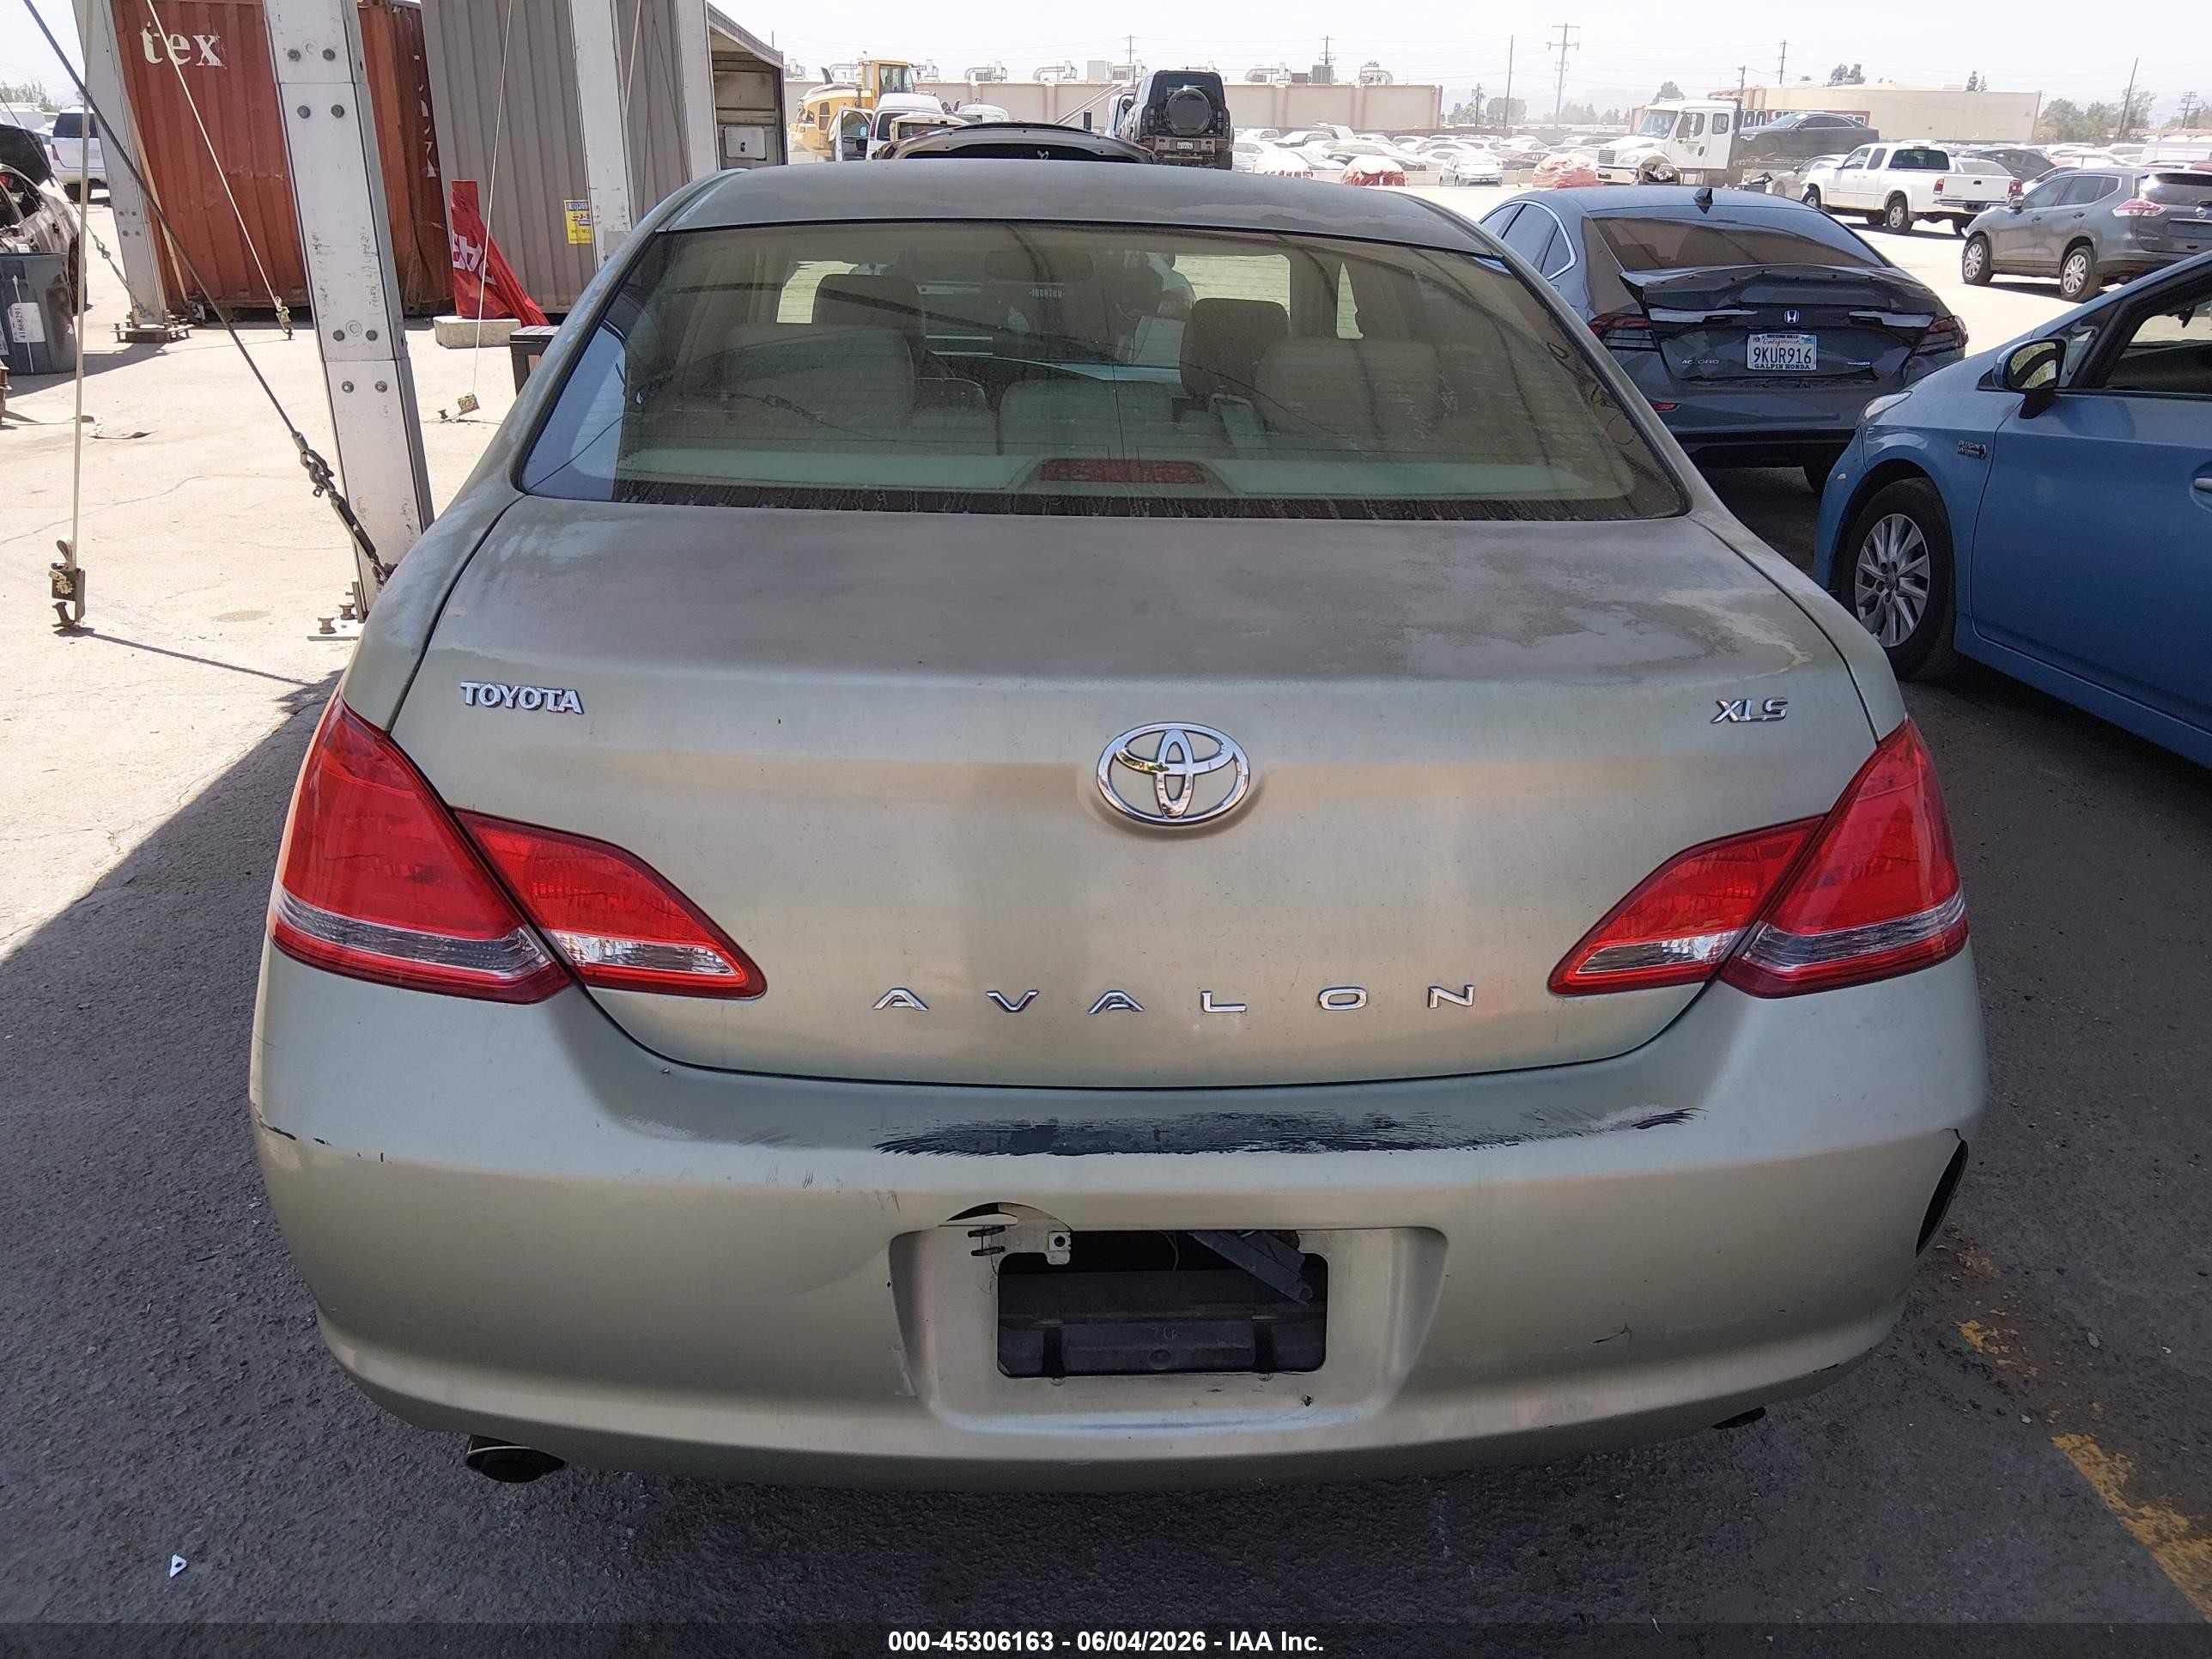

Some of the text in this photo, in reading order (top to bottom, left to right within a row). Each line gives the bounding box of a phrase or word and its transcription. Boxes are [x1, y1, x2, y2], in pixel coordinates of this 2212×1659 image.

[140, 21, 224, 67] tex
[1753, 347, 1812, 364] 9KUR916
[460, 681, 584, 714] TOYOTA
[1711, 698, 1788, 723] XLS
[872, 984, 1474, 1013] AVALON
